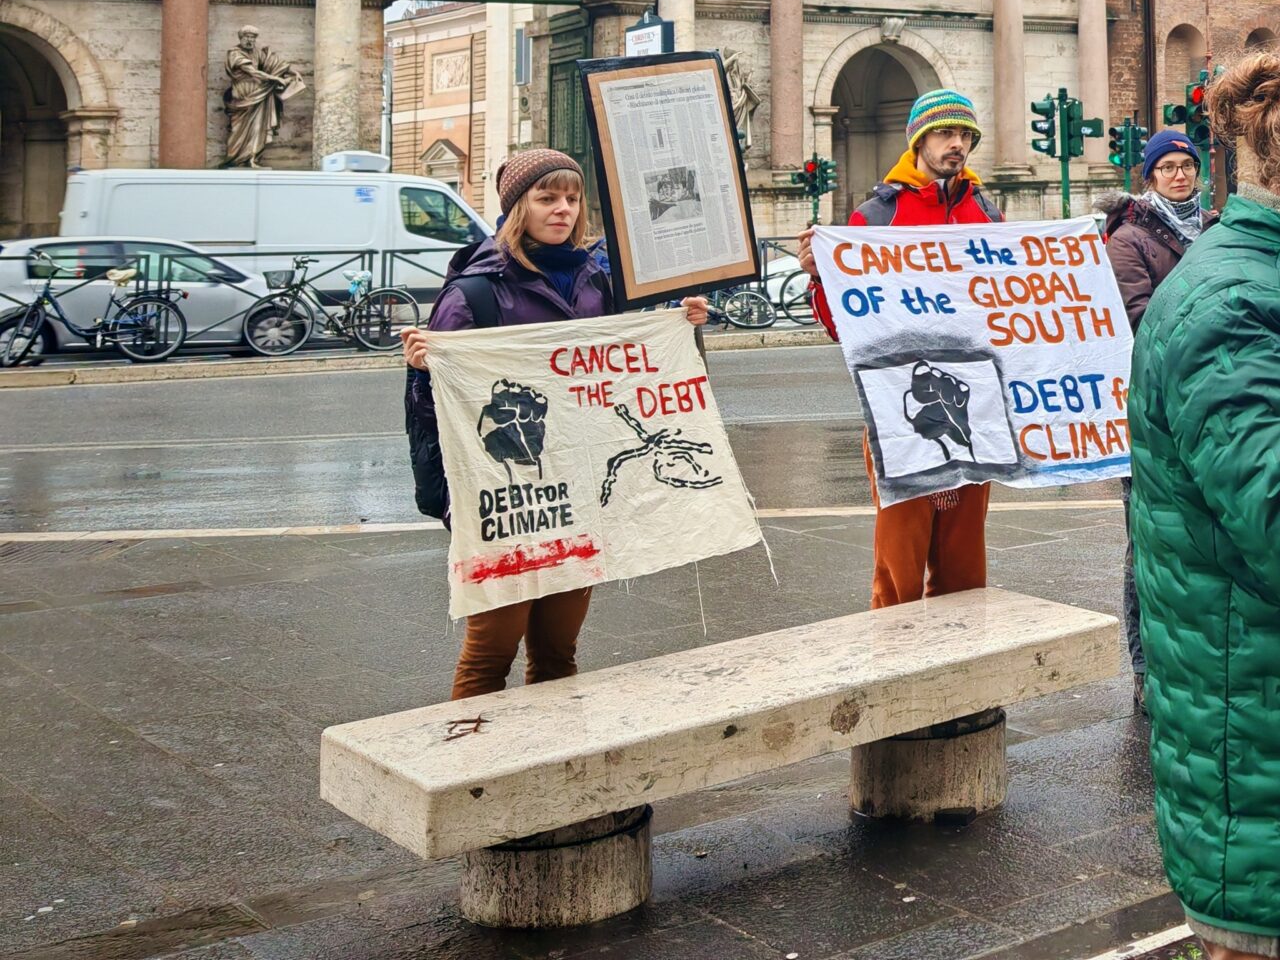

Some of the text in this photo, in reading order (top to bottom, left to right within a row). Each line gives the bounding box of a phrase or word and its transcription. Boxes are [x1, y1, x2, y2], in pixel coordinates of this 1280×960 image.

[833, 234, 1101, 276] CANCEL the DEBT
[841, 272, 1092, 317] OF the GLOBAL
[987, 306, 1115, 347] SOUTH
[550, 343, 659, 376] CANCEL
[568, 376, 707, 418] THE DEBT
[1008, 374, 1105, 414] DEBT
[479, 482, 569, 519] DEBT FOR
[480, 503, 574, 541] CLIMATE
